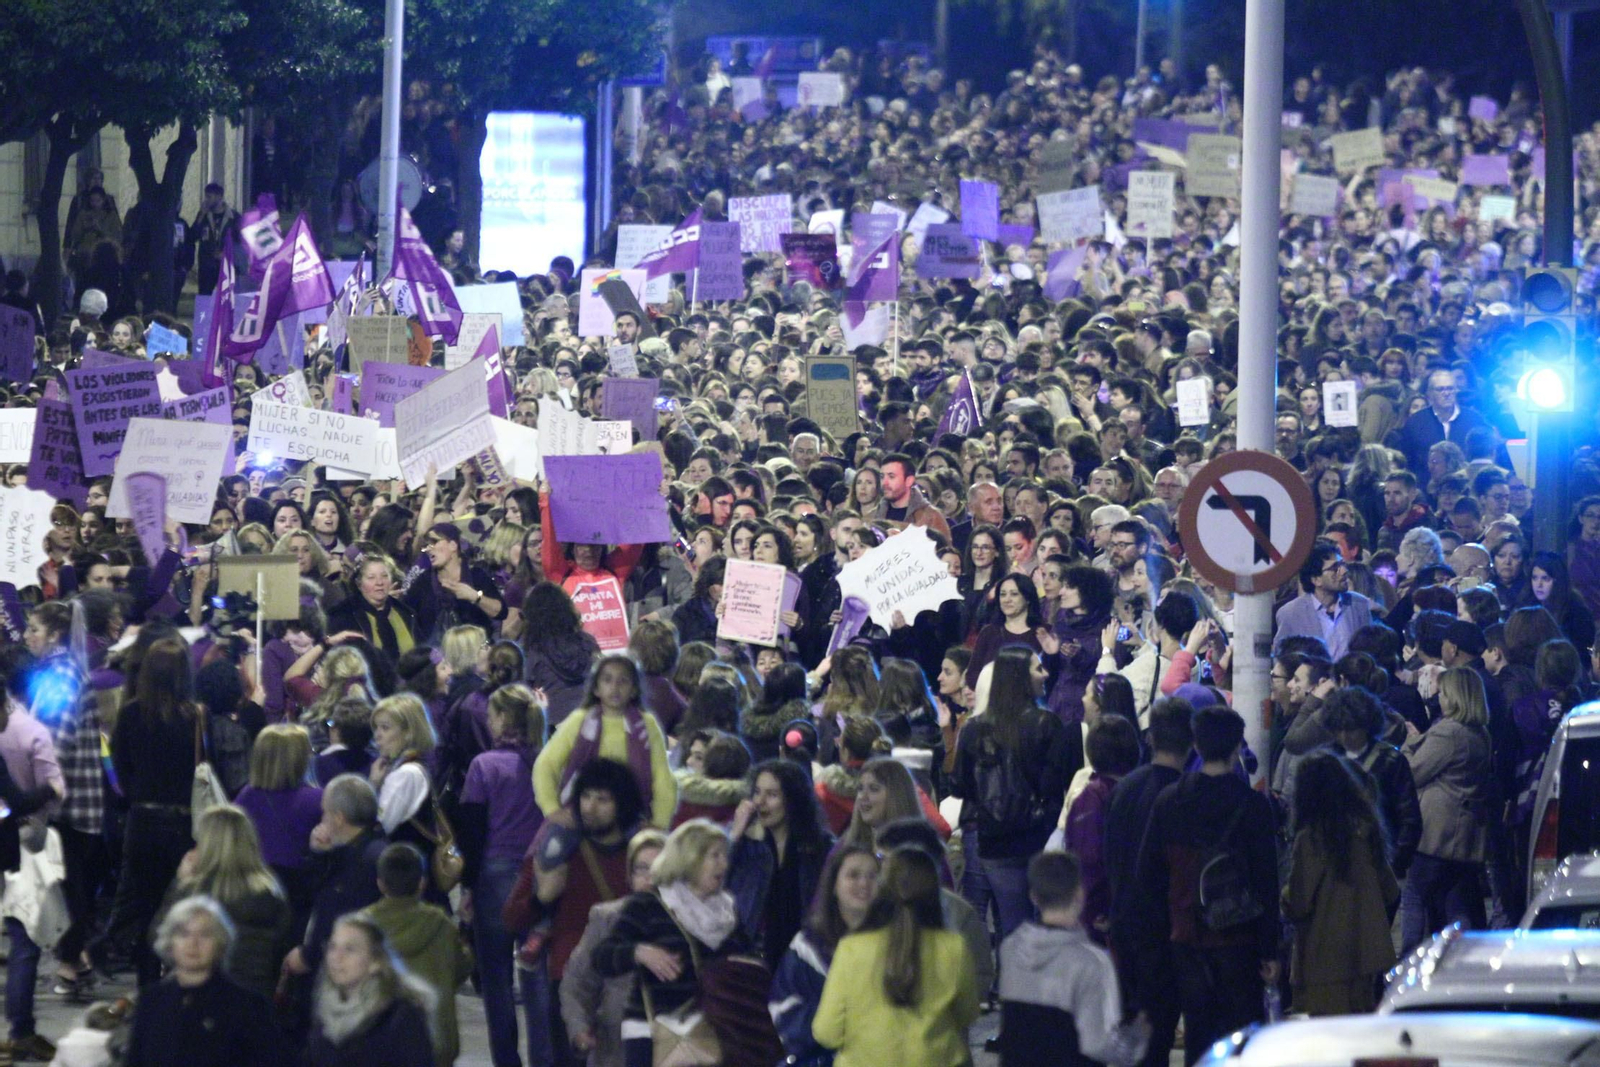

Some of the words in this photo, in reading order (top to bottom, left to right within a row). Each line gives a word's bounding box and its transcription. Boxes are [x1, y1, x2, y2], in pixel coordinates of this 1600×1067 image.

[74, 375, 99, 391] LOS
[120, 405, 141, 420] QUE
[252, 402, 299, 421] MUJER
[308, 411, 320, 426] SI
[325, 415, 346, 431] NO
[92, 428, 127, 446] MINIFA
[257, 419, 308, 437] LUCHAS
[322, 430, 364, 447] NADIE
[252, 435, 272, 450] TE
[287, 441, 351, 464] ESCUCHA
[877, 559, 925, 595] UNIDAS
[892, 591, 904, 604] LA
[903, 570, 948, 598] IGUALDAD
[574, 590, 615, 603] APUNTA
[590, 601, 604, 611] MI
